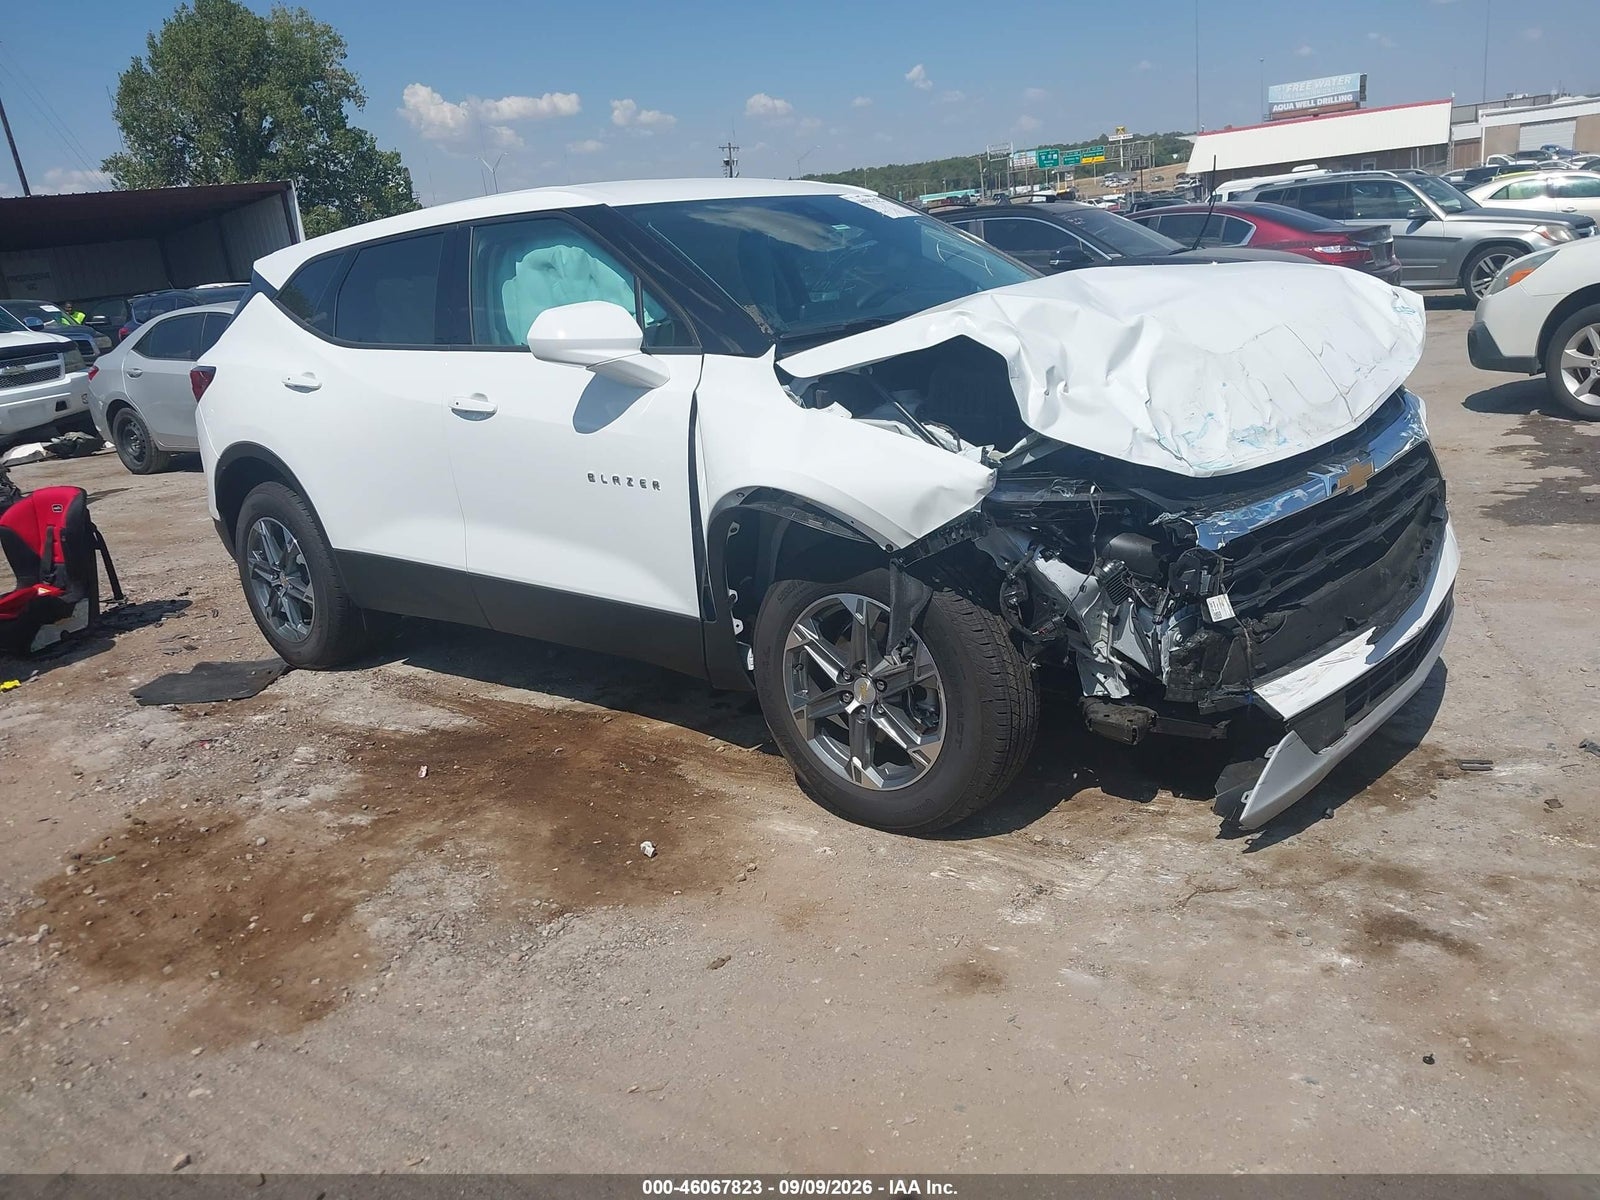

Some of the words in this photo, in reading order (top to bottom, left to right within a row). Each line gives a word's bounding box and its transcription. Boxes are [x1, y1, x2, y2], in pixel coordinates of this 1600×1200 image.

[1285, 81, 1313, 92] FREE
[1315, 76, 1352, 89] WATER
[1272, 102, 1294, 112] AQUA
[1295, 99, 1316, 109] WELL
[1317, 94, 1353, 106] DRILLING
[587, 472, 661, 491] BLAZER
